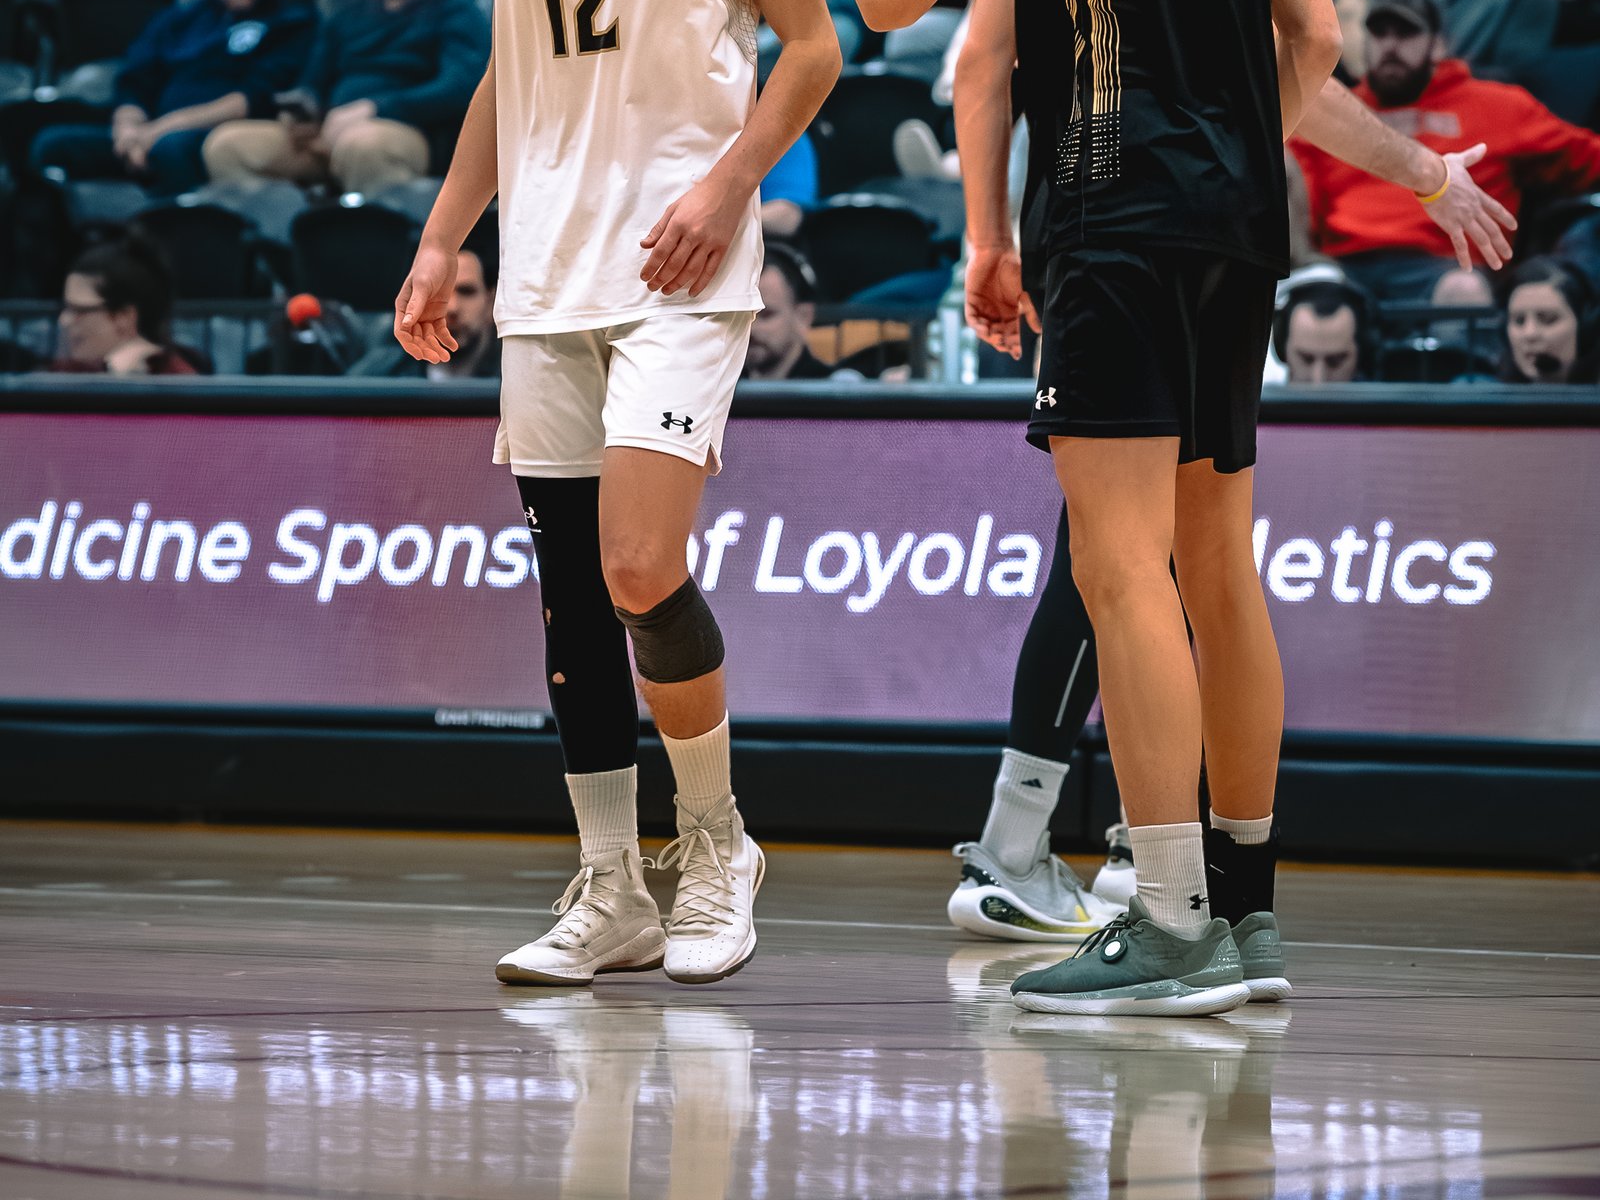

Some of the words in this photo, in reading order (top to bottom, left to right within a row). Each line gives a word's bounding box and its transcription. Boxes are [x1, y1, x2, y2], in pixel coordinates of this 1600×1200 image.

[0, 498, 251, 583] dicine
[267, 506, 541, 603] Spons
[685, 509, 746, 592] f
[754, 513, 1043, 613] Loyola
[1252, 516, 1497, 605] letics
